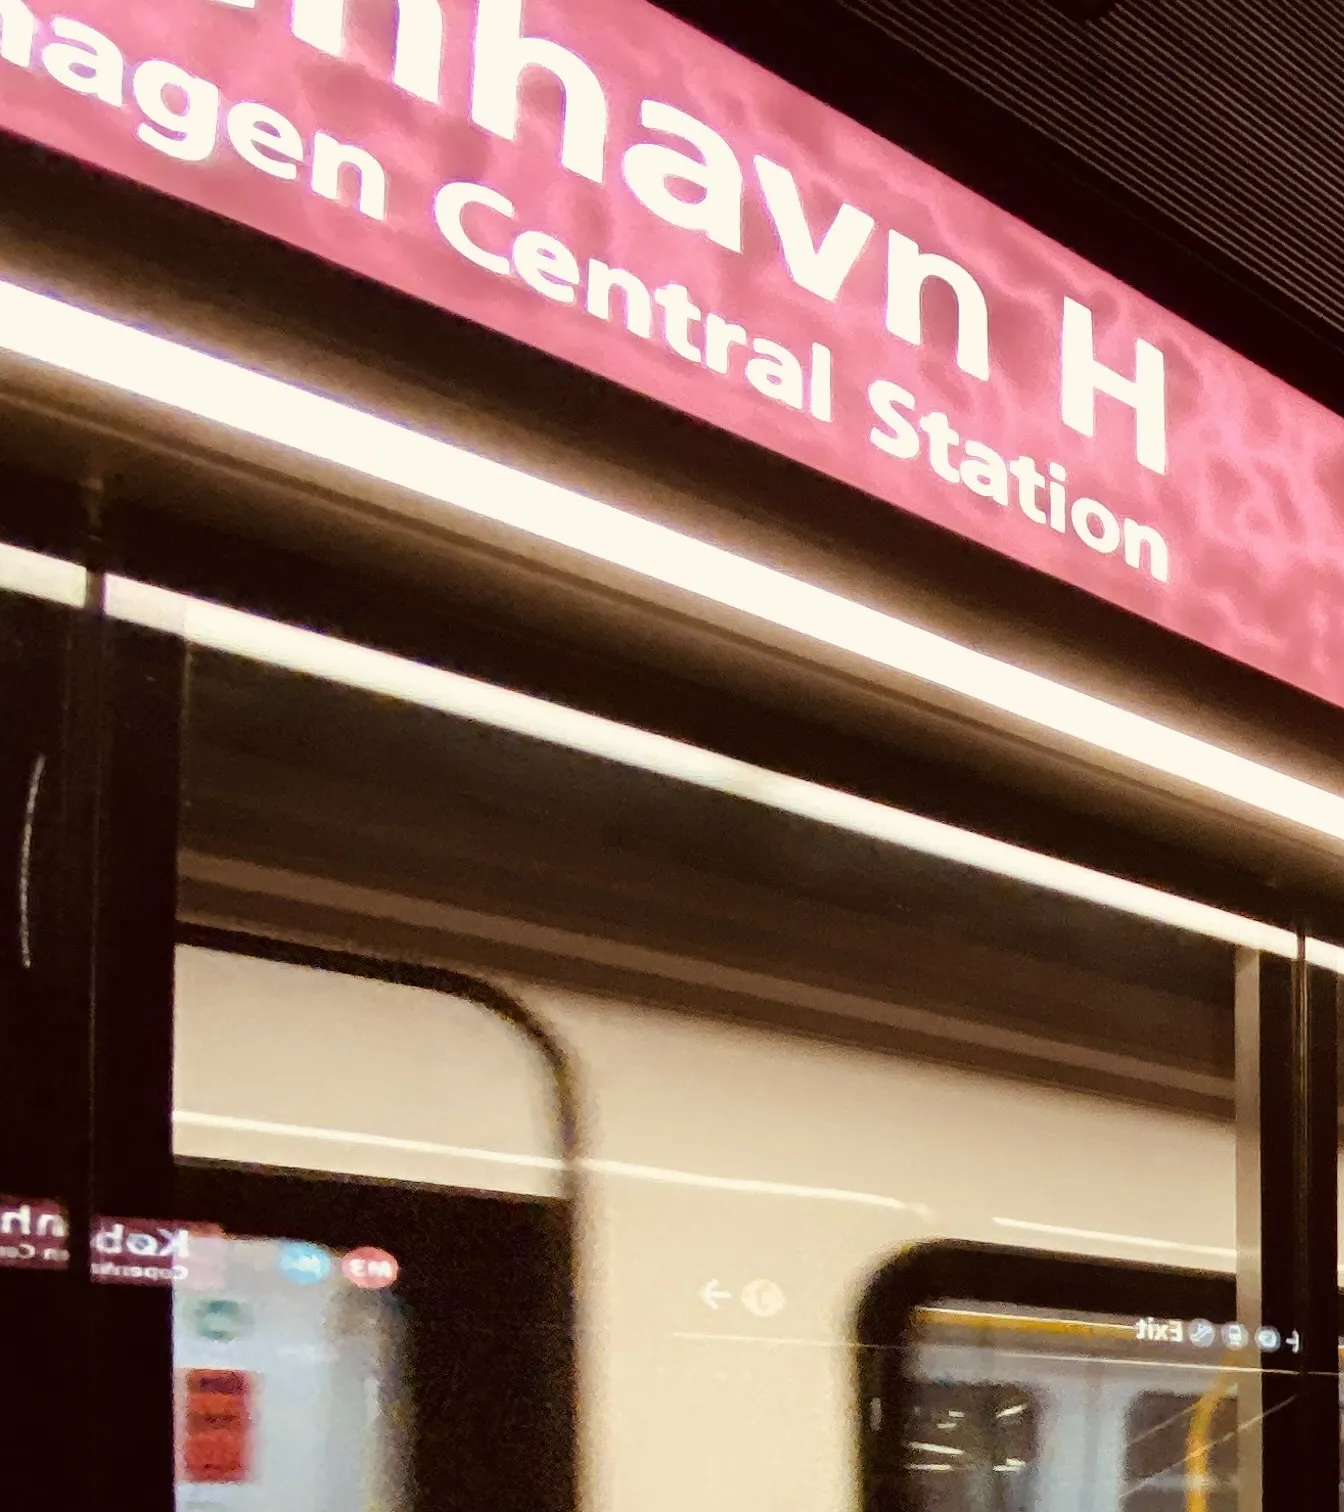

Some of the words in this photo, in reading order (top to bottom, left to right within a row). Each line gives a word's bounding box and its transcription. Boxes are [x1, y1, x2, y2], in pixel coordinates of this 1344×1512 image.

[204, 0, 990, 382] nhavn
[1060, 295, 1167, 476] H
[433, 180, 832, 423] Central
[866, 378, 1168, 582] Station
